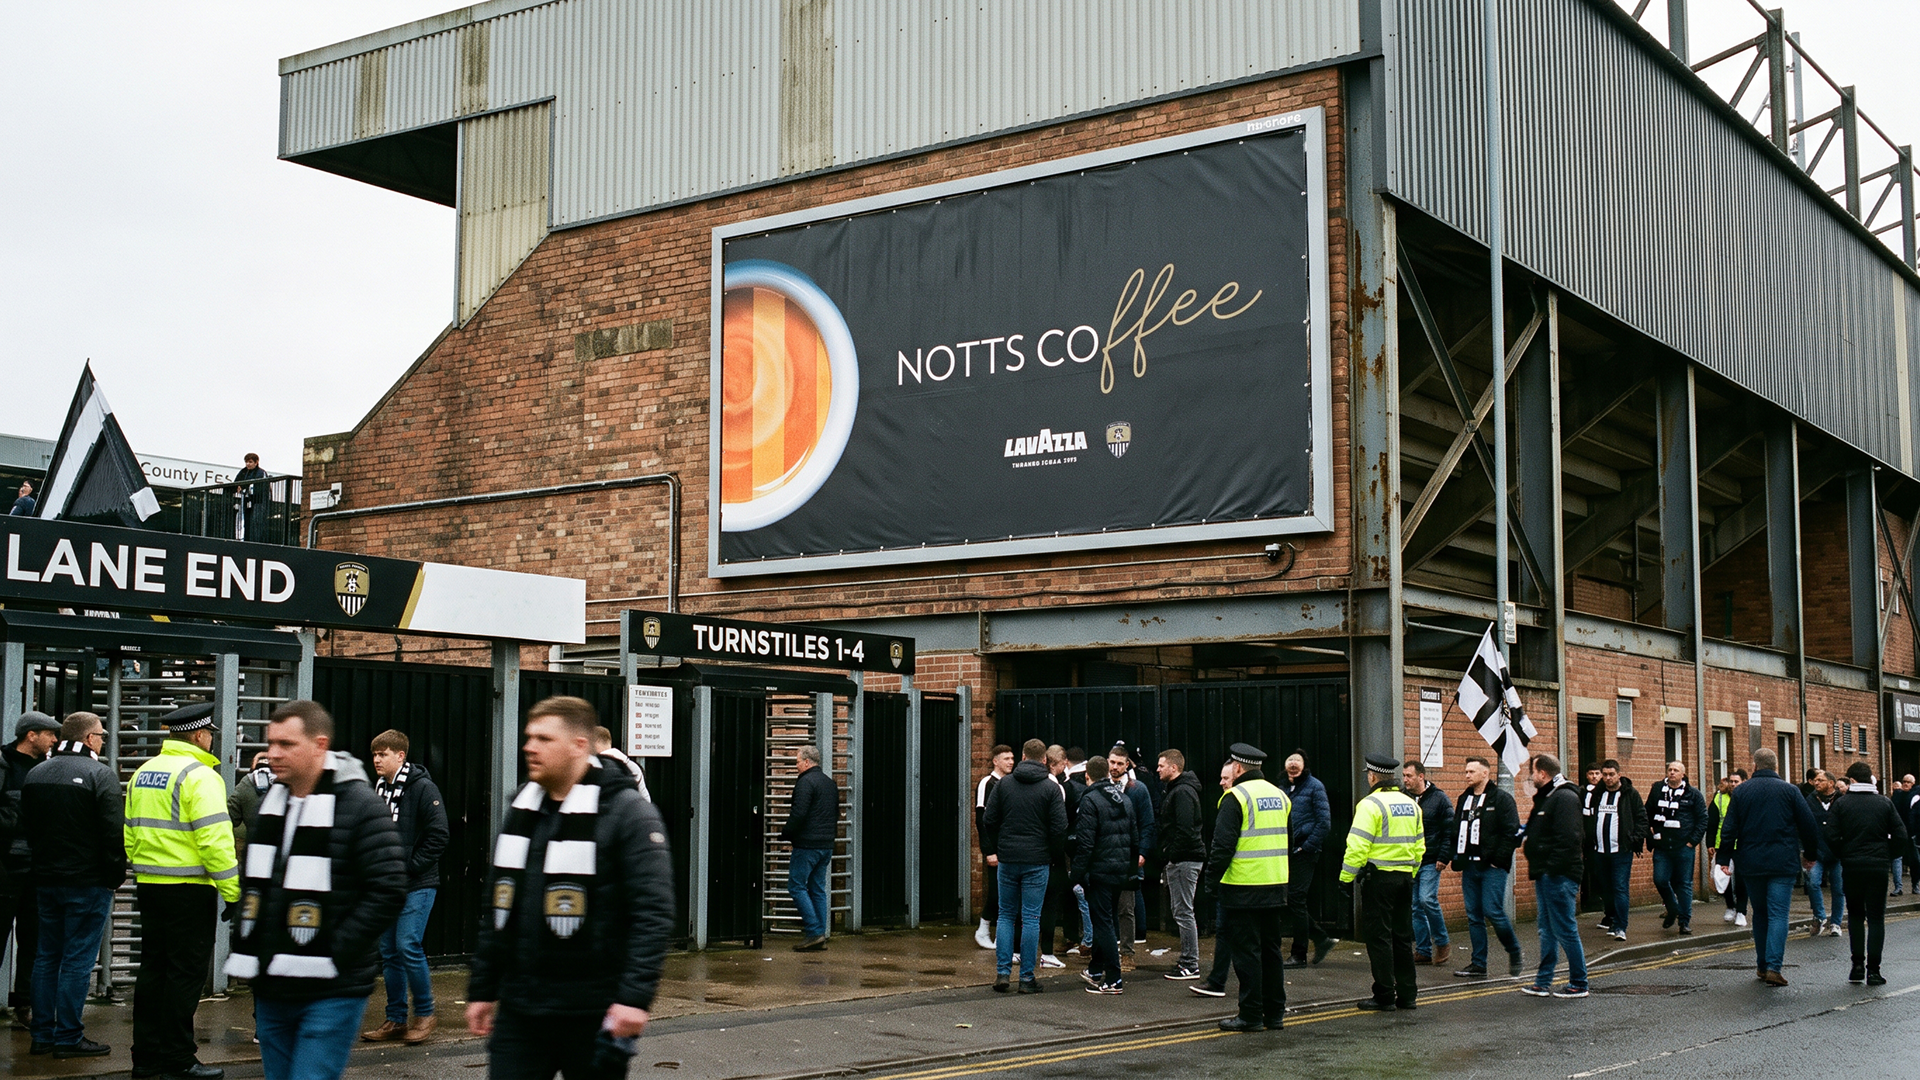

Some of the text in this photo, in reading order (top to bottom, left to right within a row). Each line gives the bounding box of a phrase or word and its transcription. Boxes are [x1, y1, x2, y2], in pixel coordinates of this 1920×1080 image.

[898, 334, 1025, 386] NOTTS
[1004, 428, 1088, 457] LAVAZZA
[141, 462, 198, 485] County
[7, 533, 296, 603] LANE END
[693, 624, 865, 663] TURNSTILES 1-4
[137, 772, 169, 786] POLICE
[1258, 798, 1282, 810] POLICE
[1391, 804, 1415, 816] POLICE
